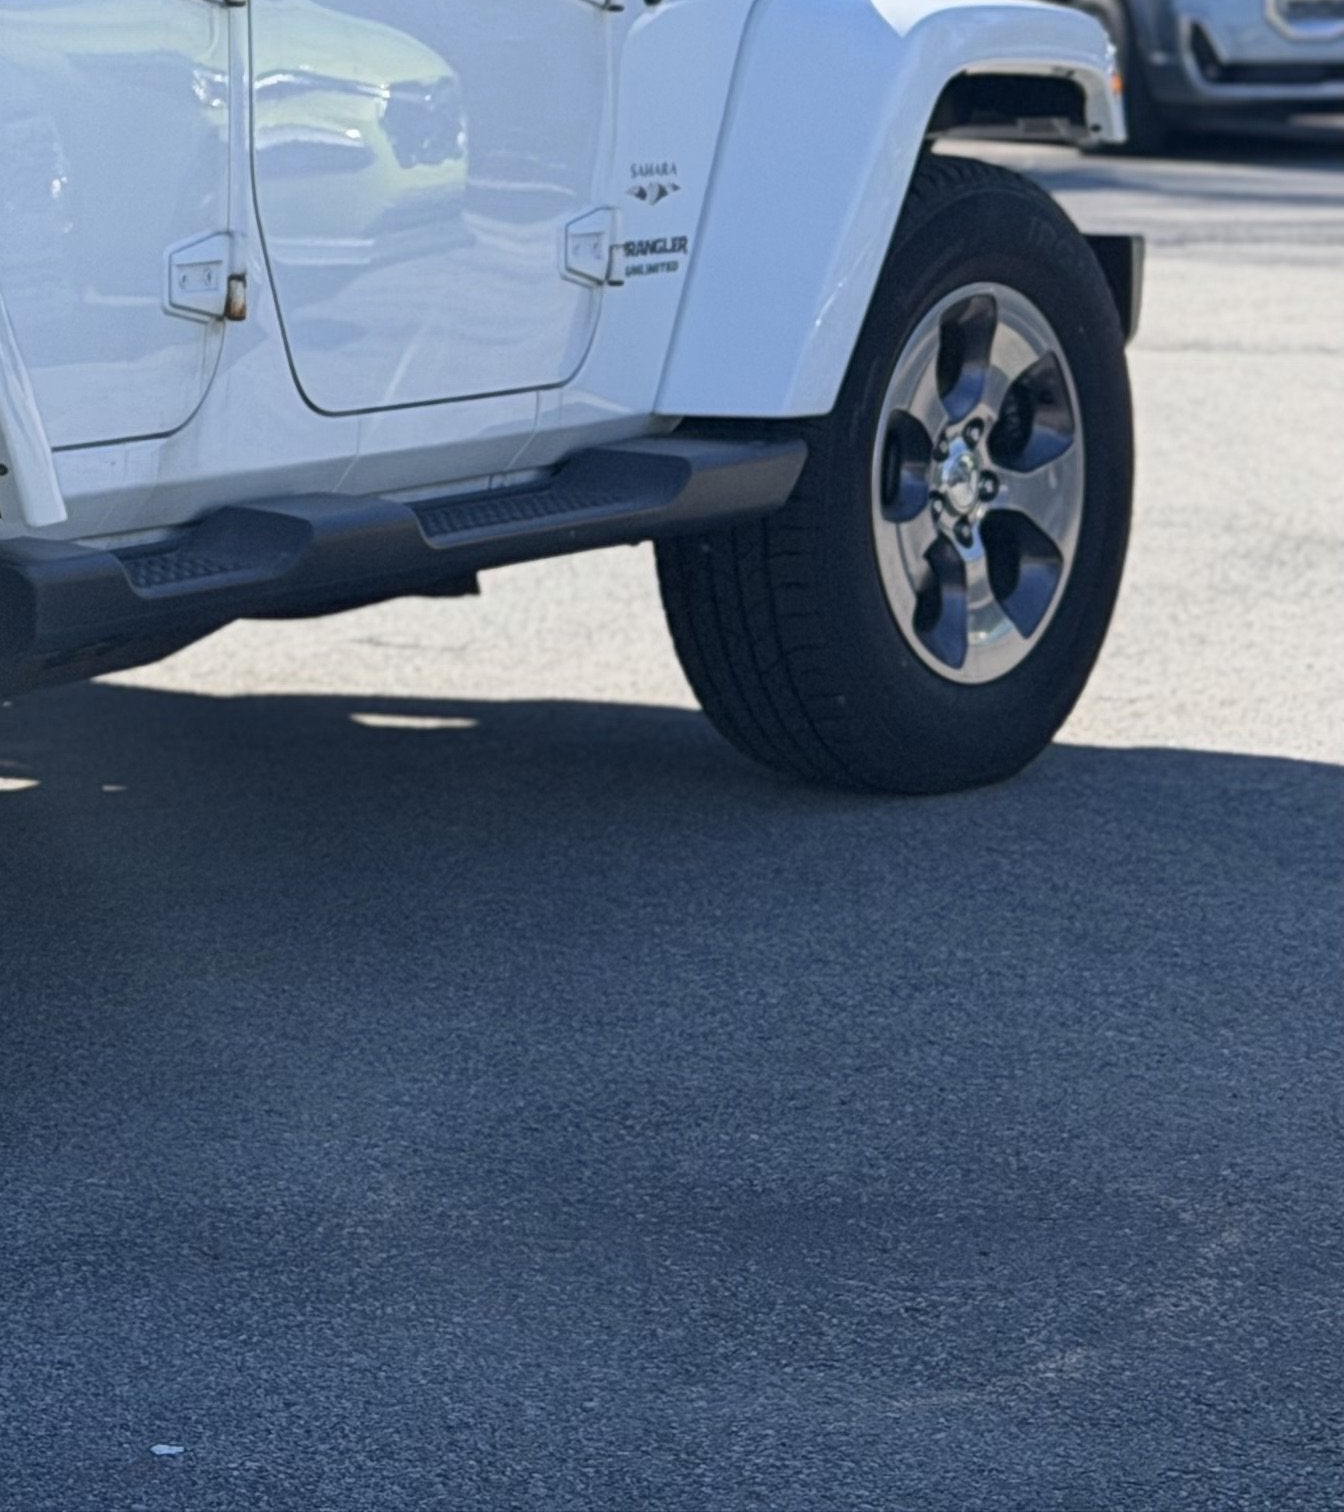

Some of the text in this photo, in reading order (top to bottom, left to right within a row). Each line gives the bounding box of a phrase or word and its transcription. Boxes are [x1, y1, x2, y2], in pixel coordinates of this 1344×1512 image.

[630, 162, 677, 179] SAHARA
[623, 235, 688, 257] RANGLER
[625, 260, 679, 277] UNLIMITED
